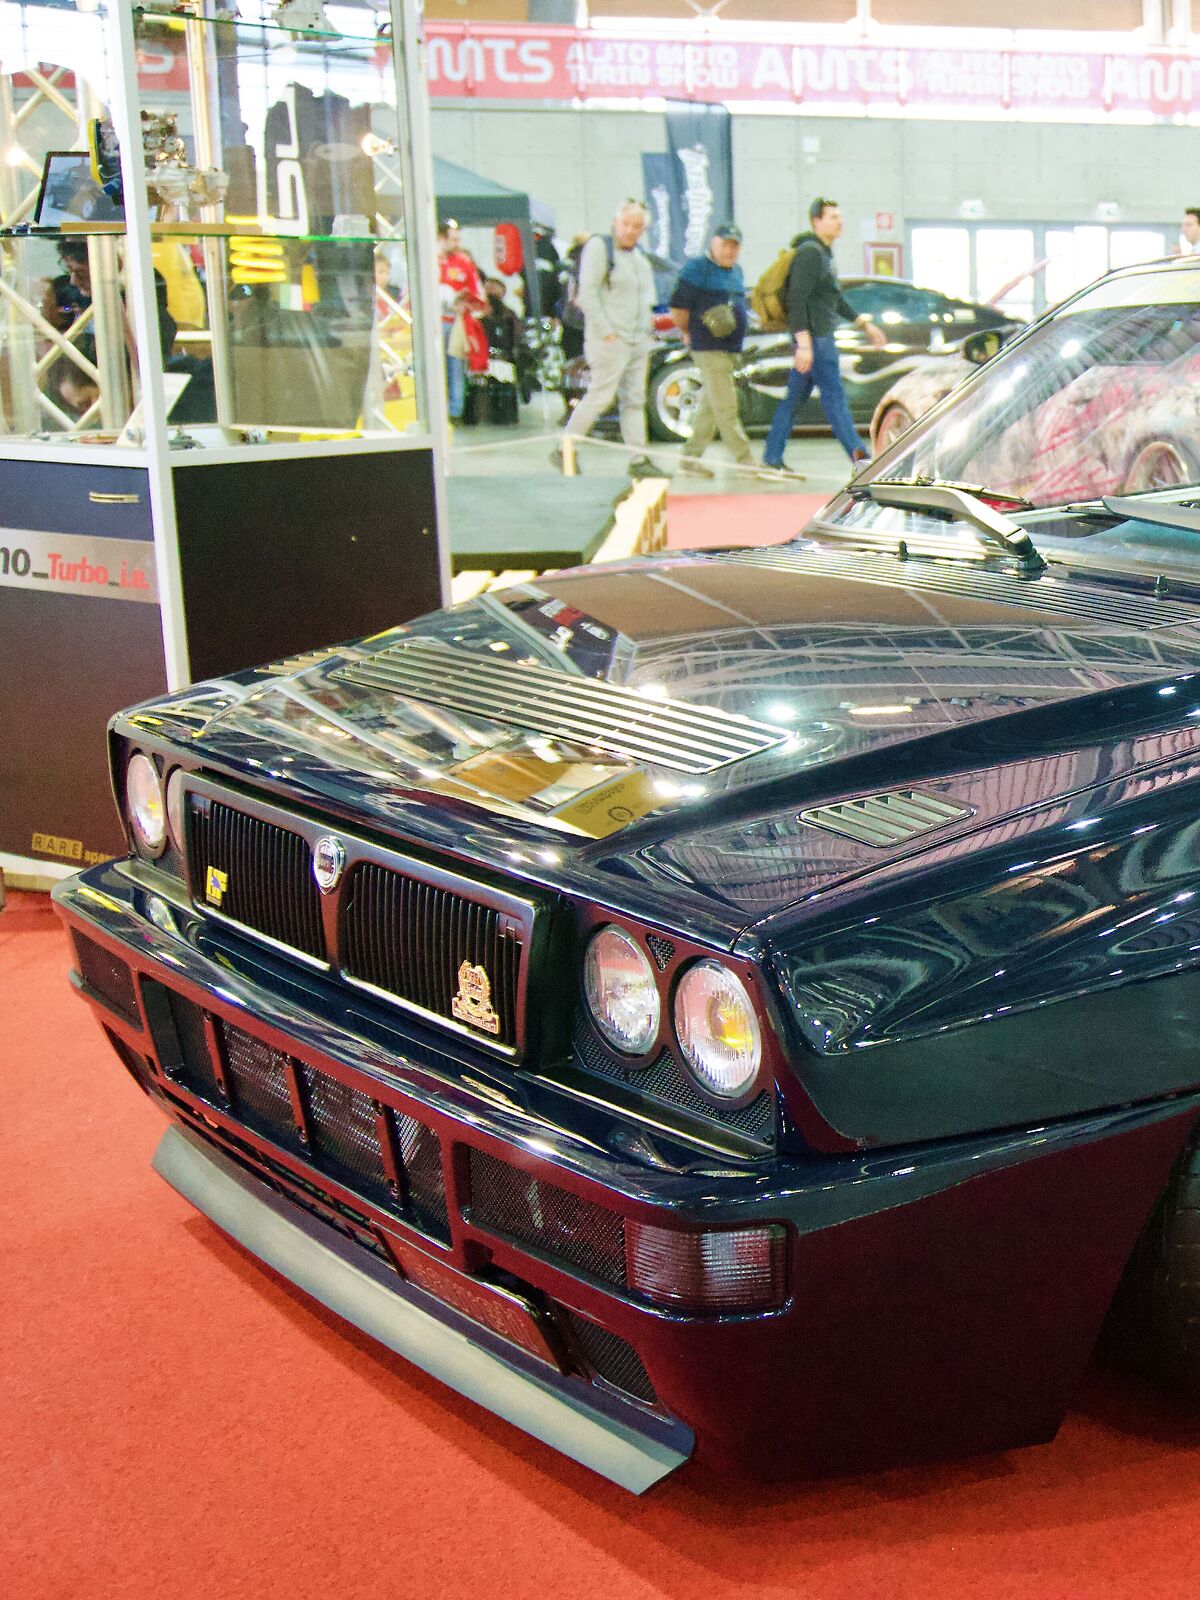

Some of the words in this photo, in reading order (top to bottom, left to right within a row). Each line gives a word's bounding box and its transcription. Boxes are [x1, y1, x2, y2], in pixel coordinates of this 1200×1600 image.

[427, 38, 553, 83] MTS
[566, 41, 650, 65] AUTO
[655, 44, 738, 68] MOTO
[752, 47, 913, 93] AMTS
[32, 832, 83, 860] RARE
